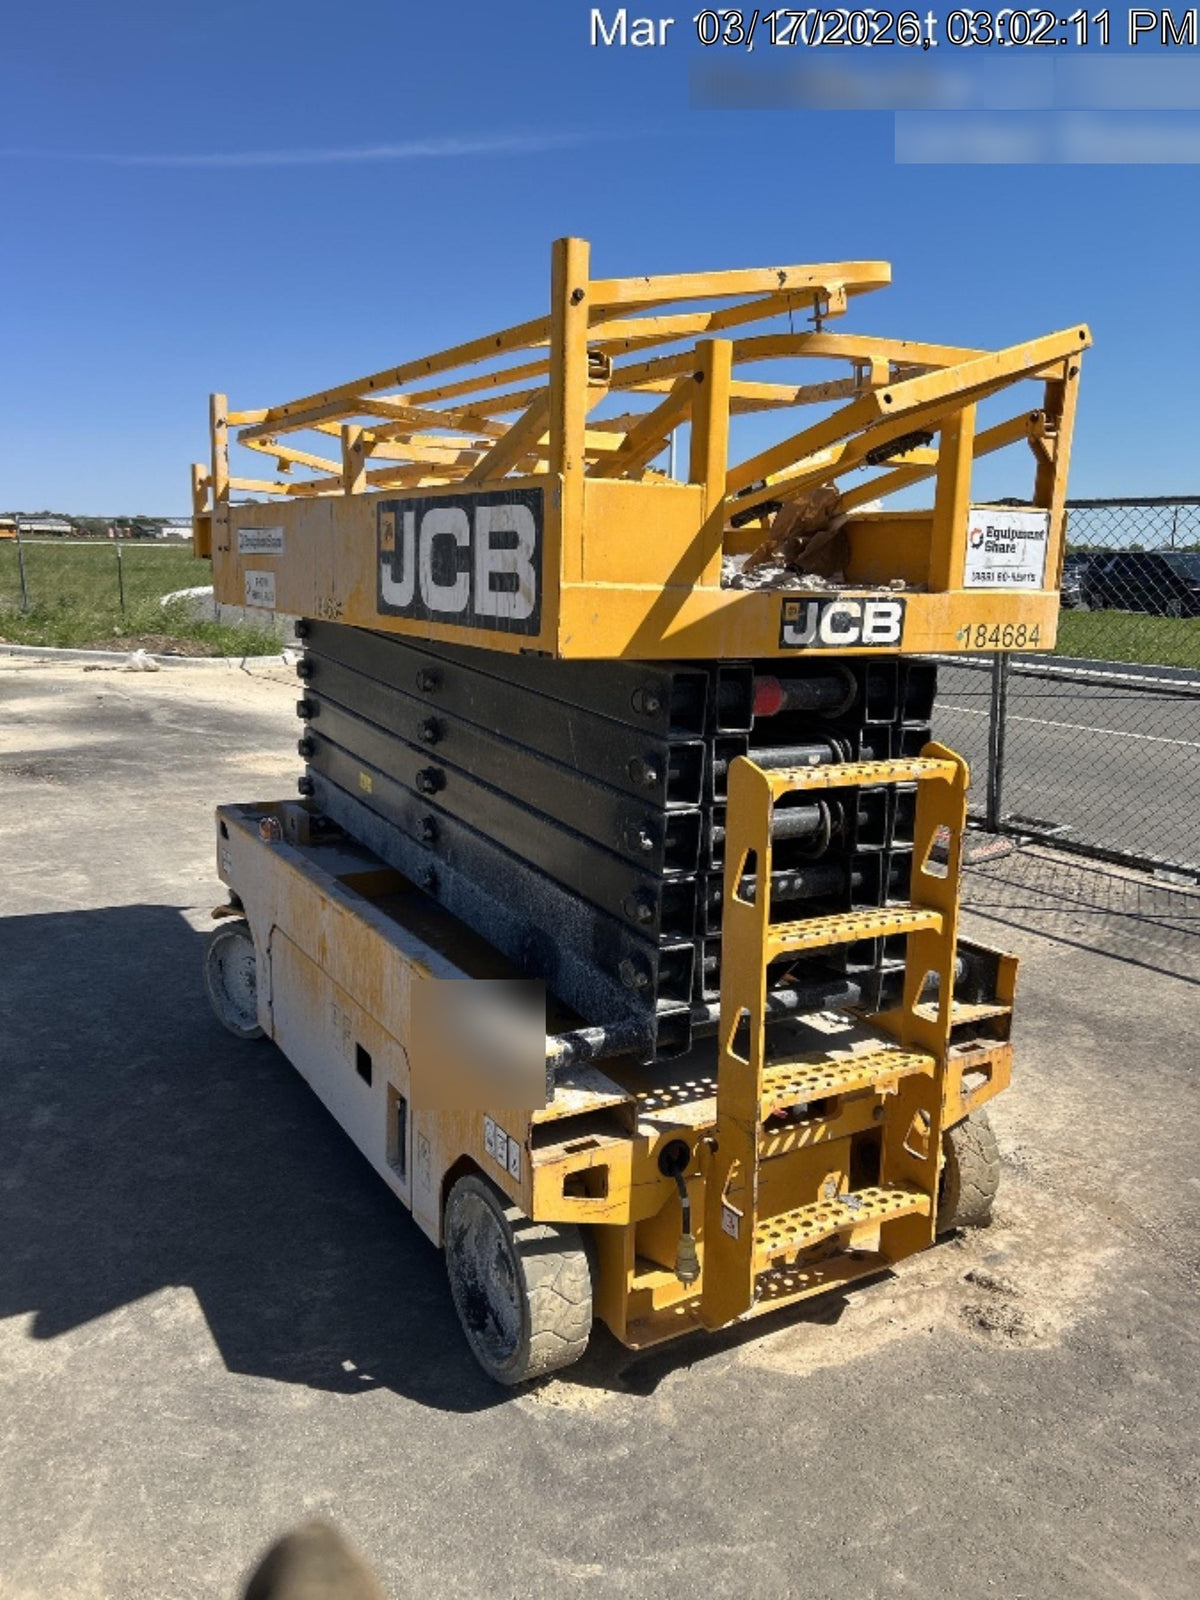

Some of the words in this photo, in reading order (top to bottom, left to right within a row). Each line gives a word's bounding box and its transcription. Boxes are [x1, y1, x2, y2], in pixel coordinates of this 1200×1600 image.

[986, 526, 1044, 541] Equipment
[984, 540, 1016, 553] Share
[381, 504, 537, 619] JCB
[783, 602, 902, 644] JCB
[963, 623, 1040, 648] 184684
